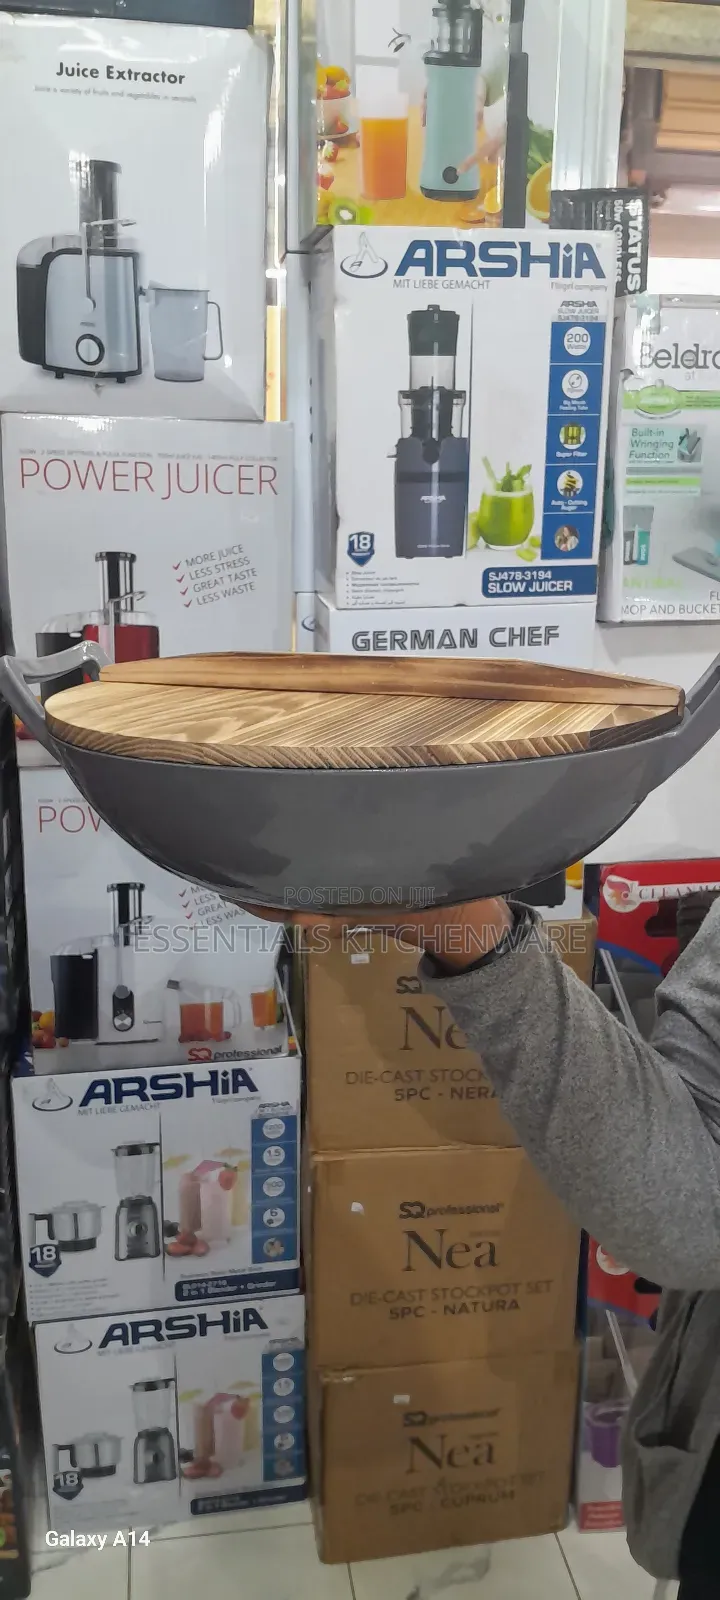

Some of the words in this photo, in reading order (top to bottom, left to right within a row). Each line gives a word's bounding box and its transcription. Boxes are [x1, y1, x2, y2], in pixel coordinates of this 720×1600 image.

[56, 62, 99, 79] Juice
[106, 65, 185, 84] Extractor
[626, 198, 643, 291] STATUS
[393, 279, 411, 289] MIT
[413, 279, 440, 289] LIEBE
[441, 279, 491, 290] GEMACHT
[567, 333, 589, 343] 200
[631, 427, 665, 437] Built-in
[630, 439, 674, 451] Wringing
[629, 450, 670, 459] Function
[20, 457, 155, 492] POWER
[161, 462, 278, 500] JUICER
[350, 534, 371, 551] 18
[185, 552, 216, 567] MORE
[217, 544, 243, 561] JUICE
[189, 567, 213, 580] LESS
[214, 556, 250, 573] STRESS
[488, 570, 552, 581] SJ478-3194
[193, 577, 224, 592] GREAT
[228, 567, 257, 583] TASTE
[488, 581, 527, 593] SLOW
[529, 580, 573, 592] JUICER
[196, 592, 220, 605] LESS
[221, 581, 256, 598] WASTE
[649, 604, 675, 614] AND
[351, 628, 478, 651] GERMAN
[489, 625, 559, 648] CHEF
[194, 893, 216, 905] LESS
[198, 901, 228, 916] GREAT
[400, 1006, 469, 1050] Ne
[214, 1044, 282, 1060] professional
[345, 1069, 425, 1085] DIE-CAST
[427, 1203, 500, 1218] professional
[31, 1245, 56, 1263] 18
[402, 1229, 500, 1272] Nea
[350, 1289, 427, 1307] DIE-CAST
[431, 1282, 522, 1300] STOCKPOT
[526, 1279, 554, 1295] SET
[443, 1299, 521, 1316] NATURA
[404, 1434, 497, 1475] Nea
[55, 1472, 79, 1487] 18
